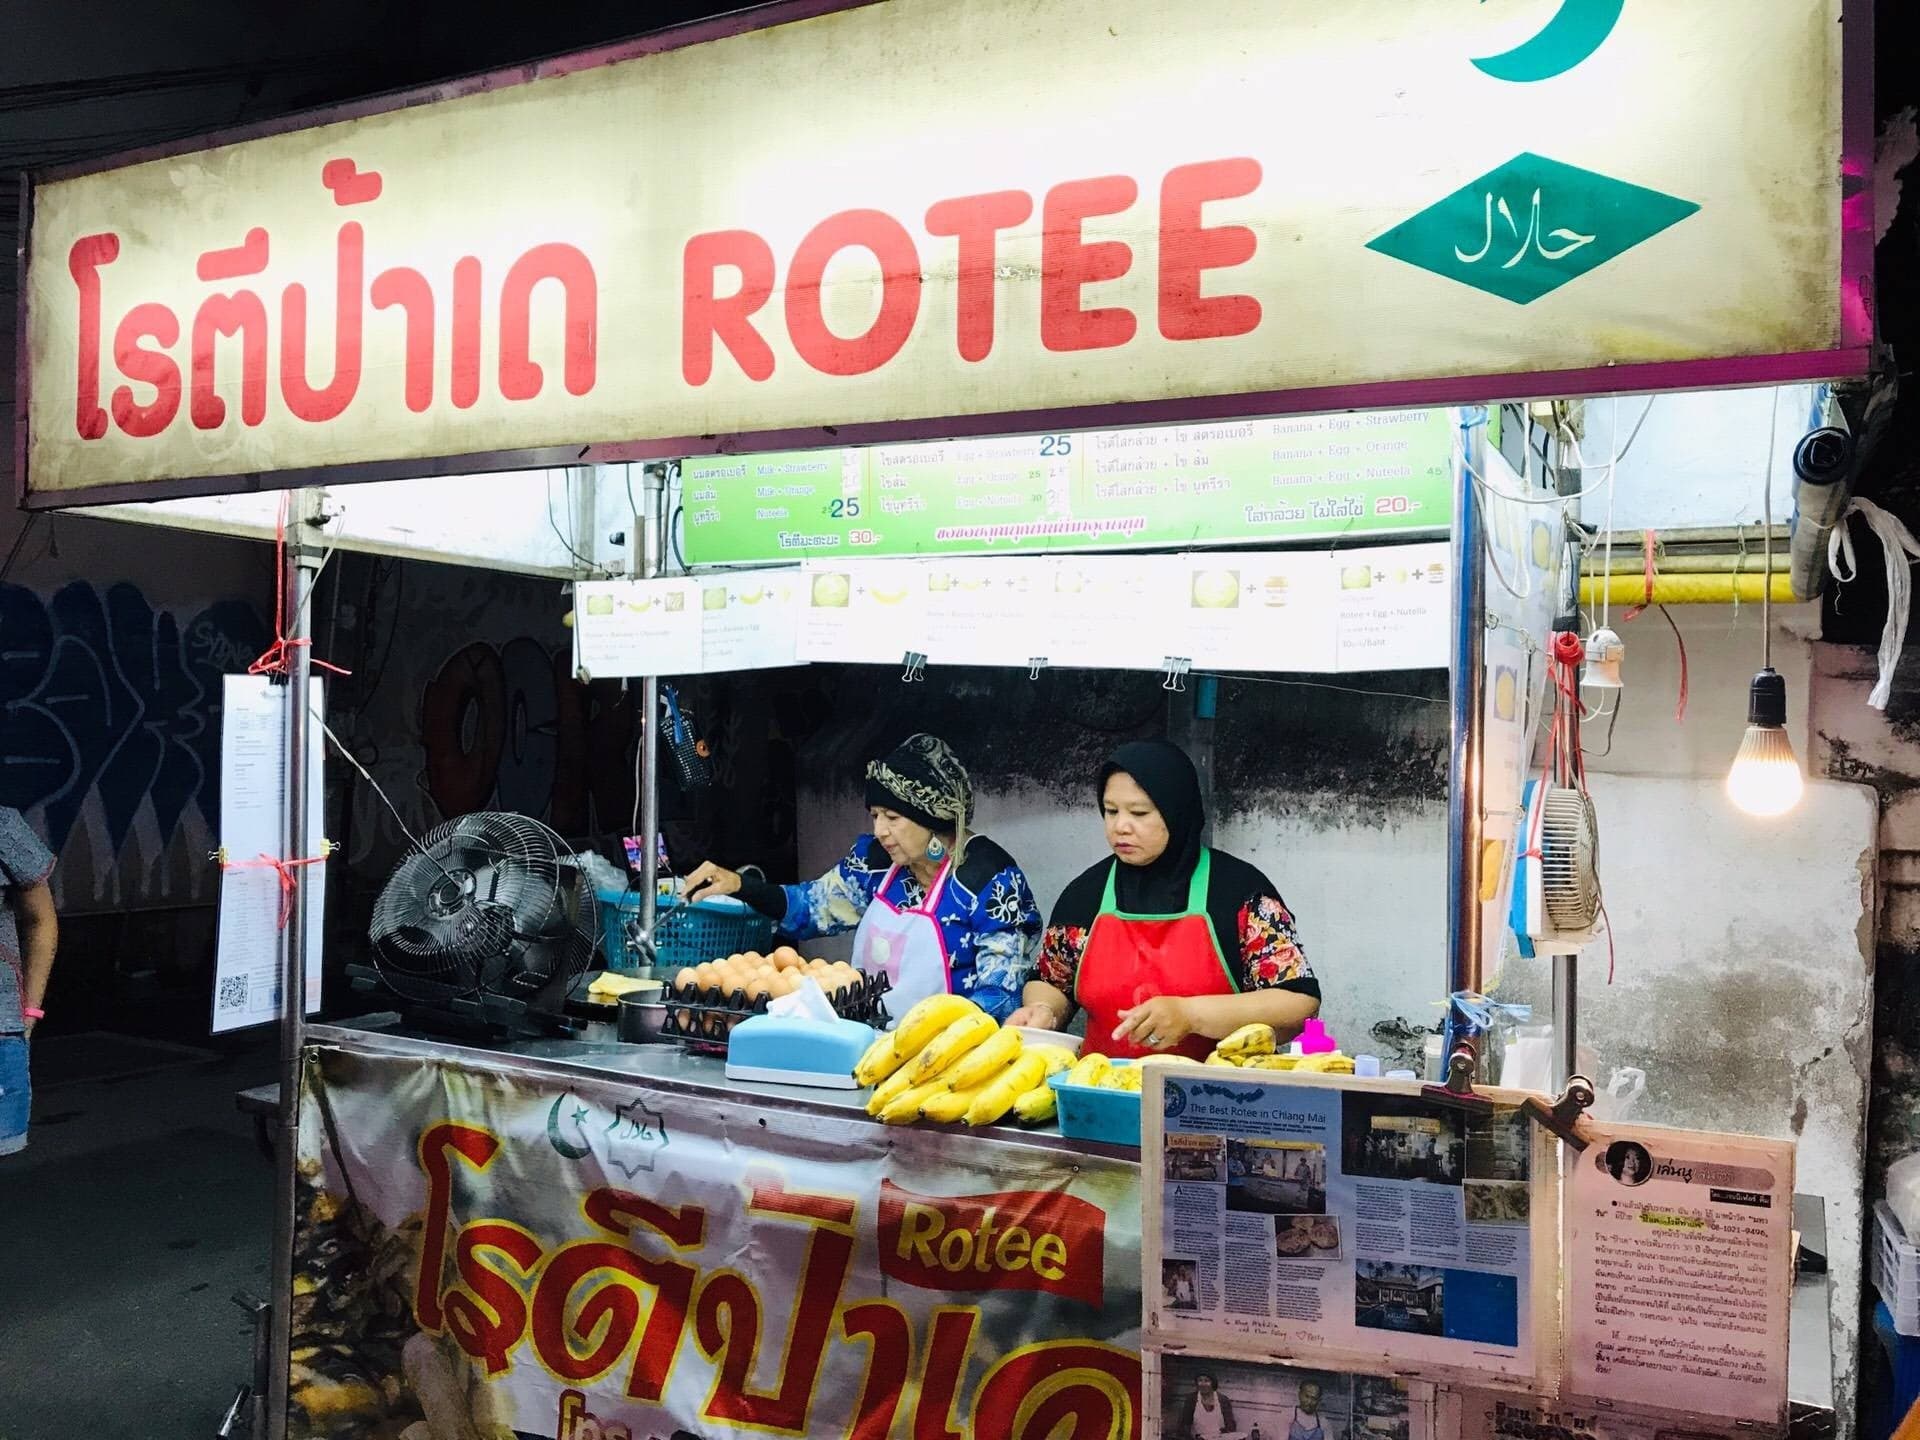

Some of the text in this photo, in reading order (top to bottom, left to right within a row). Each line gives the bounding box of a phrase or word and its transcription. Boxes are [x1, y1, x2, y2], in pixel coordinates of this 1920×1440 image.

[1455, 187, 1596, 268] حلال
[70, 159, 597, 438] โรตีป้าเด
[683, 159, 1262, 387] ROTEE
[1366, 411, 1430, 426] Strawberry
[1039, 435, 1072, 457] 25
[830, 496, 860, 519] 25
[1190, 1103, 1207, 1114] The
[1209, 1104, 1229, 1116] Best
[1230, 1106, 1258, 1118] Rotee
[1271, 1109, 1306, 1124] Chiang
[1307, 1112, 1327, 1124] Mai
[897, 1201, 1068, 1282] Rotee
